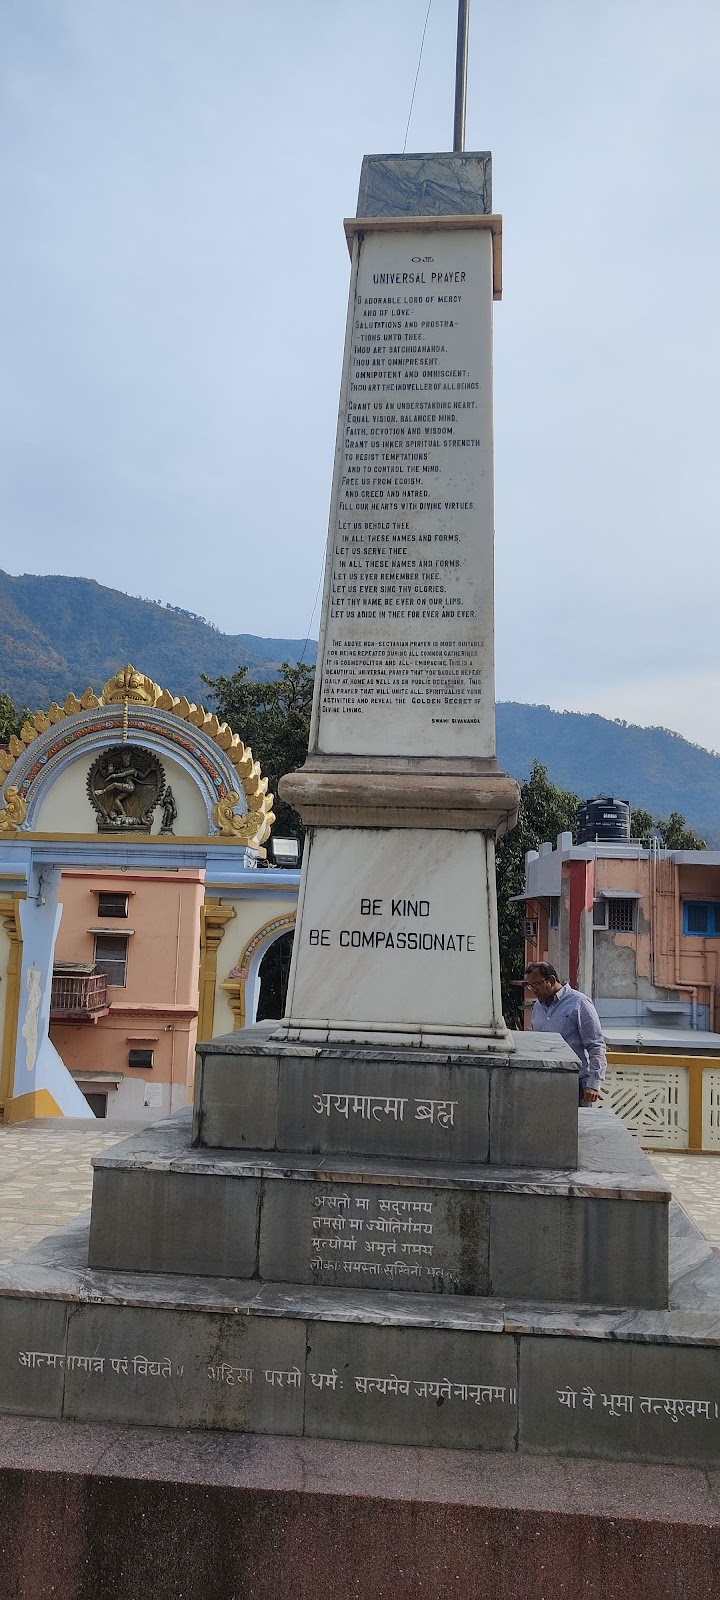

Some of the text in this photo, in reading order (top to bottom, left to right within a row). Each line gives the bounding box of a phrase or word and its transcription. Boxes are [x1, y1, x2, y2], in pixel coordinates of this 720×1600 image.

[373, 271, 466, 284] UNIVERSAL PRAYER
[358, 295, 362, 305] O
[354, 345, 370, 354] THOU
[353, 358, 370, 367] THOU
[372, 358, 385, 367] ART
[350, 383, 367, 392] THOU
[368, 383, 380, 392] ART
[434, 382, 442, 391] OF
[348, 401, 371, 411] GRANT
[347, 414, 369, 423] EQUAL
[400, 414, 436, 423] BALANCED
[370, 427, 404, 436] DEVOTION
[345, 439, 368, 449] GRANT
[342, 476, 359, 486] FREE
[339, 501, 353, 511] FILL
[372, 502, 398, 511] HEARTS
[338, 520, 351, 530] LET
[342, 534, 349, 543] IN
[368, 534, 389, 543] THESE
[335, 546, 349, 555] LET
[333, 572, 346, 581] LET
[380, 572, 419, 581] REMEMBER
[332, 584, 346, 593] LET
[331, 597, 344, 606] LET
[330, 609, 344, 619] LET
[357, 610, 376, 619] ABIDE
[379, 610, 386, 619] IN
[388, 610, 405, 619] THEE
[360, 899, 430, 916] BE KIND
[310, 930, 476, 951] BE COMPASSIONATE
[313, 1093, 459, 1128] अयमात्मा ब्रह्म
[314, 1194, 350, 1208] असतो
[355, 1198, 370, 1210] मा
[312, 1215, 433, 1234] तमसो मा ज्योतिर्गमय
[401, 1243, 433, 1256] गमय
[109, 1356, 128, 1375] परं
[262, 1367, 301, 1387] परमो
[354, 1374, 410, 1395] सत्यमेव
[557, 1386, 577, 1408] यो
[581, 1387, 596, 1409] वै
[601, 1393, 634, 1416] भूमा
